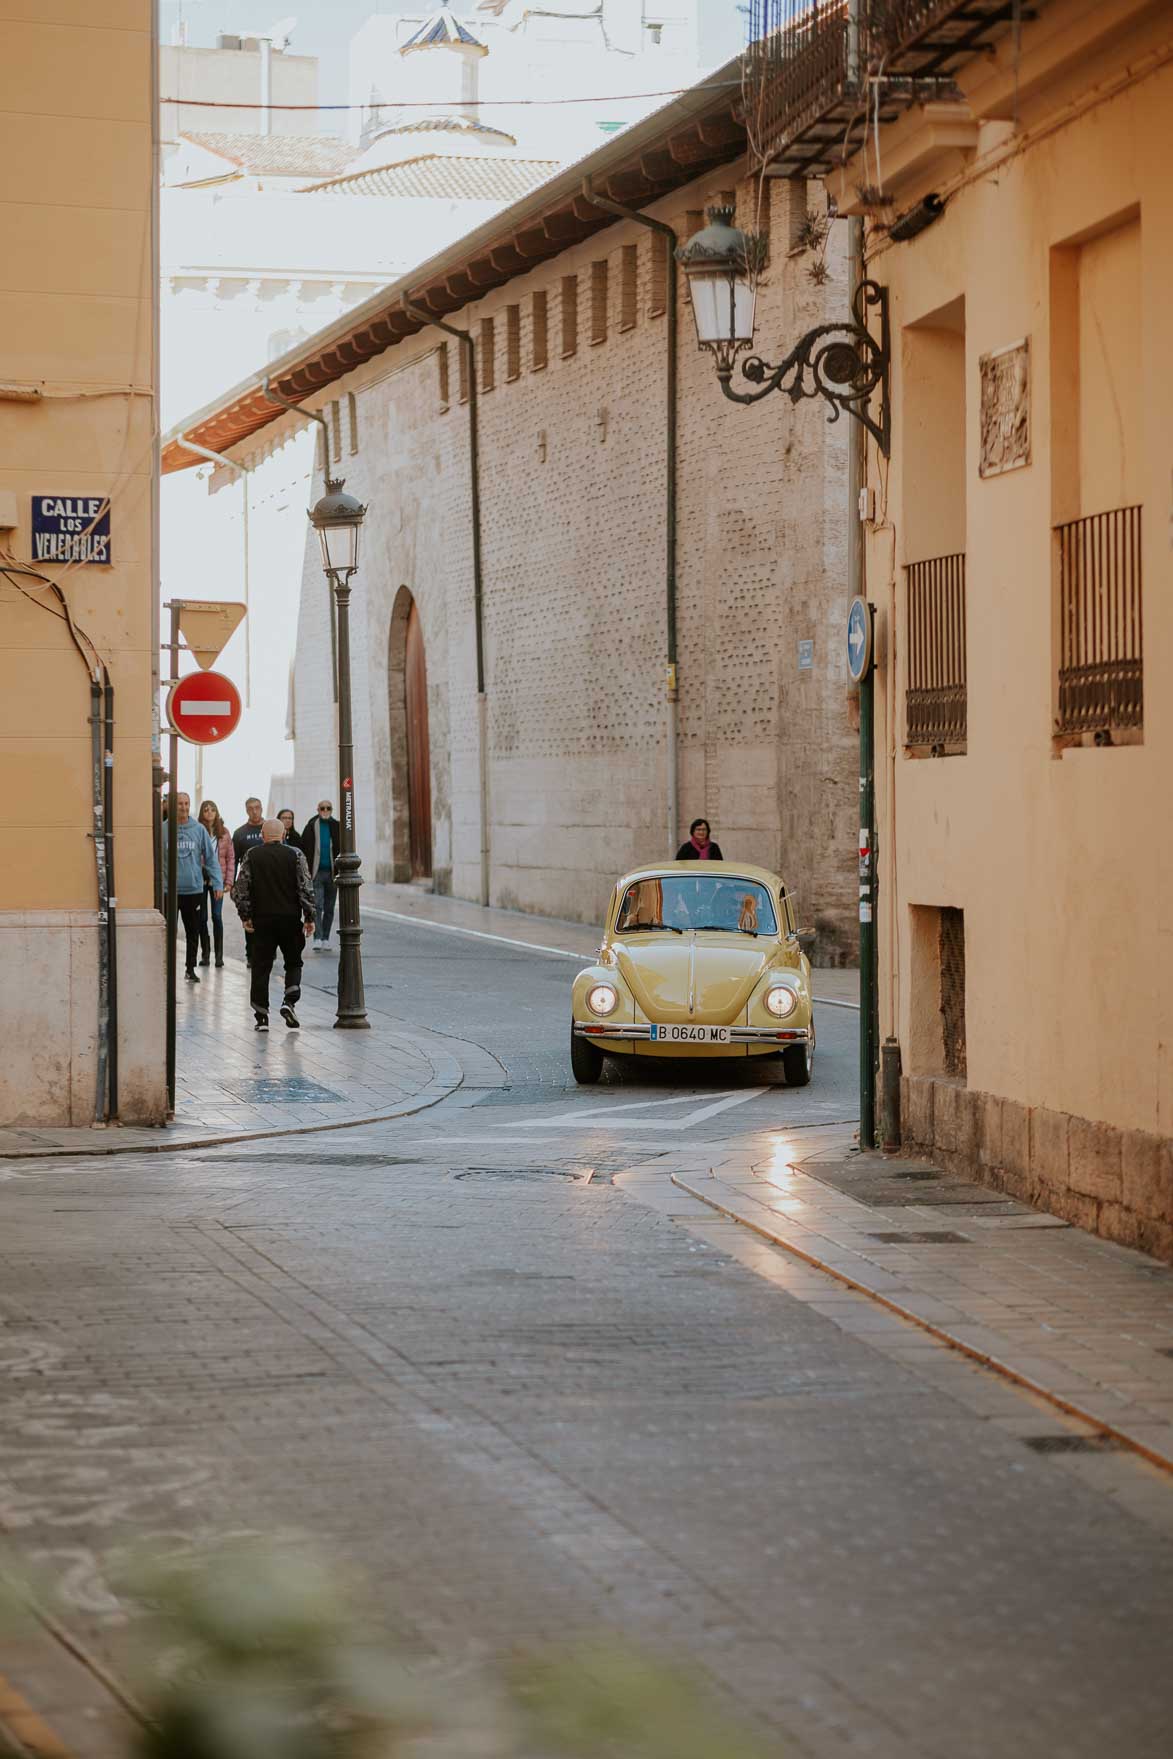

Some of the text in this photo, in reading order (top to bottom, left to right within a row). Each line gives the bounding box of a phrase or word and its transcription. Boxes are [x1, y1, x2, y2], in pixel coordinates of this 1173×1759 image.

[41, 498, 100, 517] CALLE
[60, 518, 82, 531] LOS
[35, 532, 107, 561] VENERABLES
[659, 1026, 727, 1041] B 0640 MC
